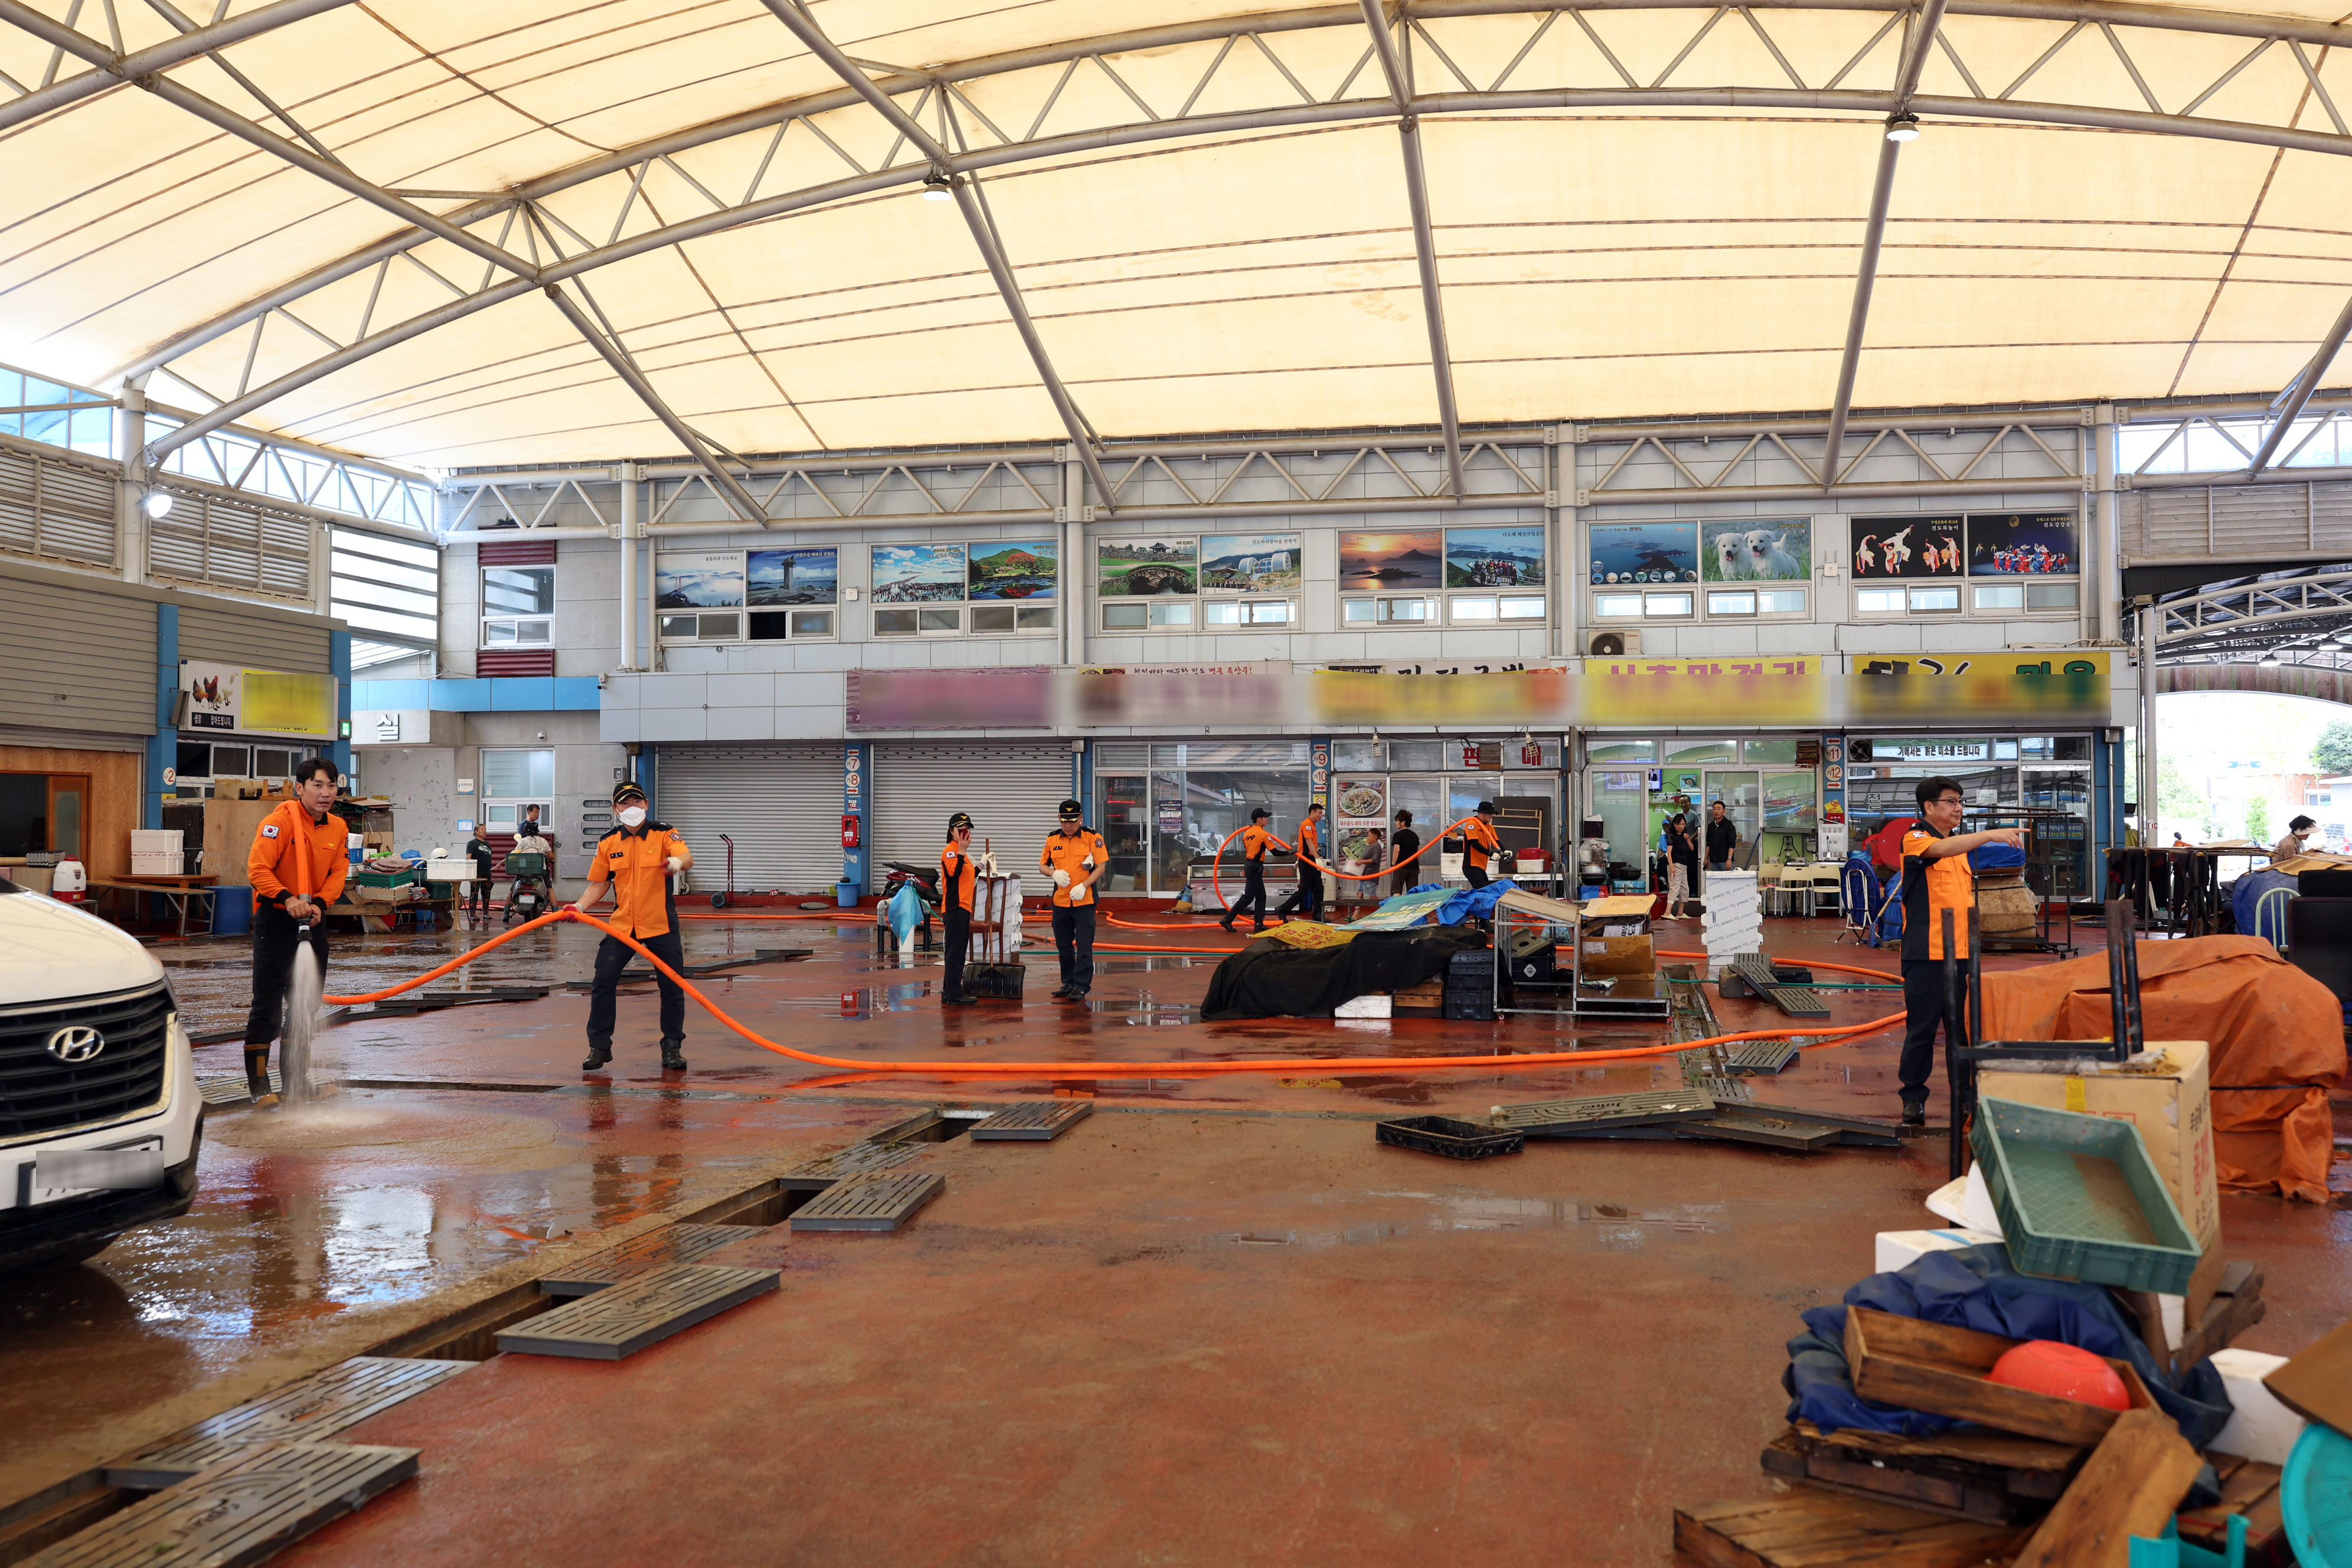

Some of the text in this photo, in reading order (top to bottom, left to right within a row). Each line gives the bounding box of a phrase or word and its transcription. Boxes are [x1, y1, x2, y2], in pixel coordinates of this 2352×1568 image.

[1925, 746, 1936, 756] 밝은
[1939, 746, 1955, 756] 미소를
[1957, 745, 1980, 756] 드립니다
